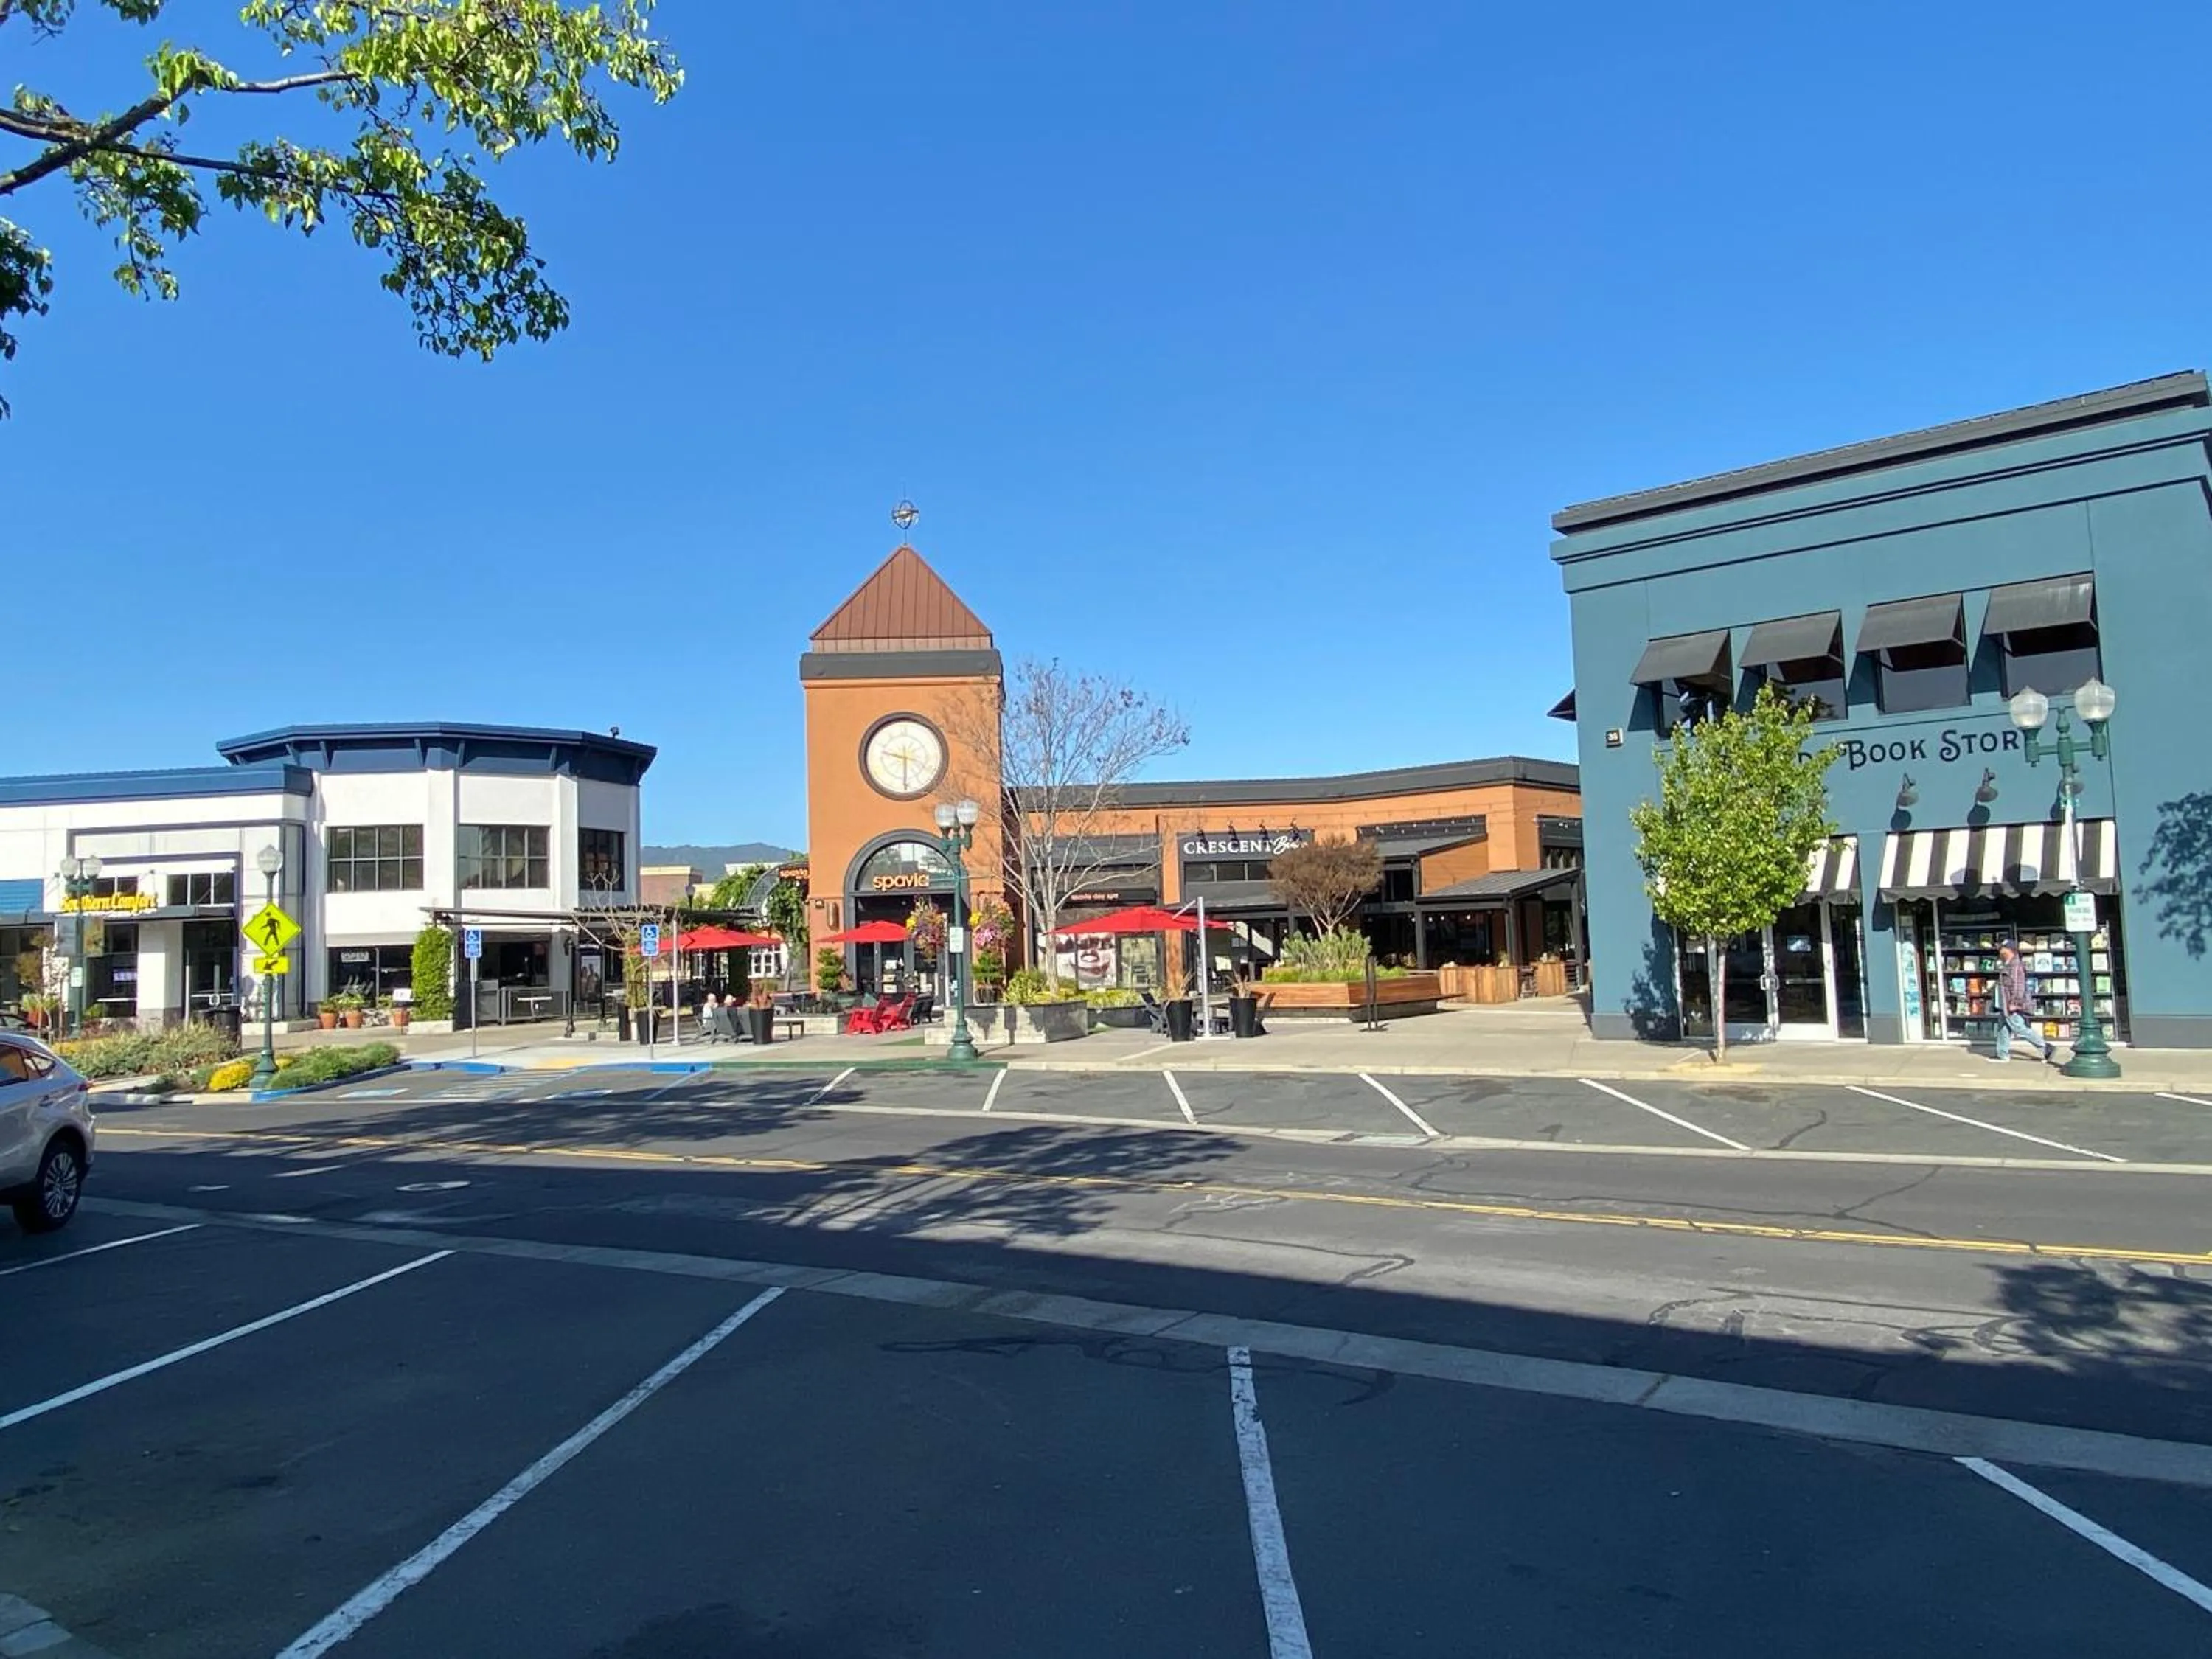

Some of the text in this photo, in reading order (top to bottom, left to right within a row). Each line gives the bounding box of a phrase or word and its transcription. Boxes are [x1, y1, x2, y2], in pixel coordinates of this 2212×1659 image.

[1838, 740, 1927, 771] BOOK
[1940, 729, 2020, 762] STOR
[1183, 839, 1273, 855] CRESCENT
[873, 873, 929, 891] spavia
